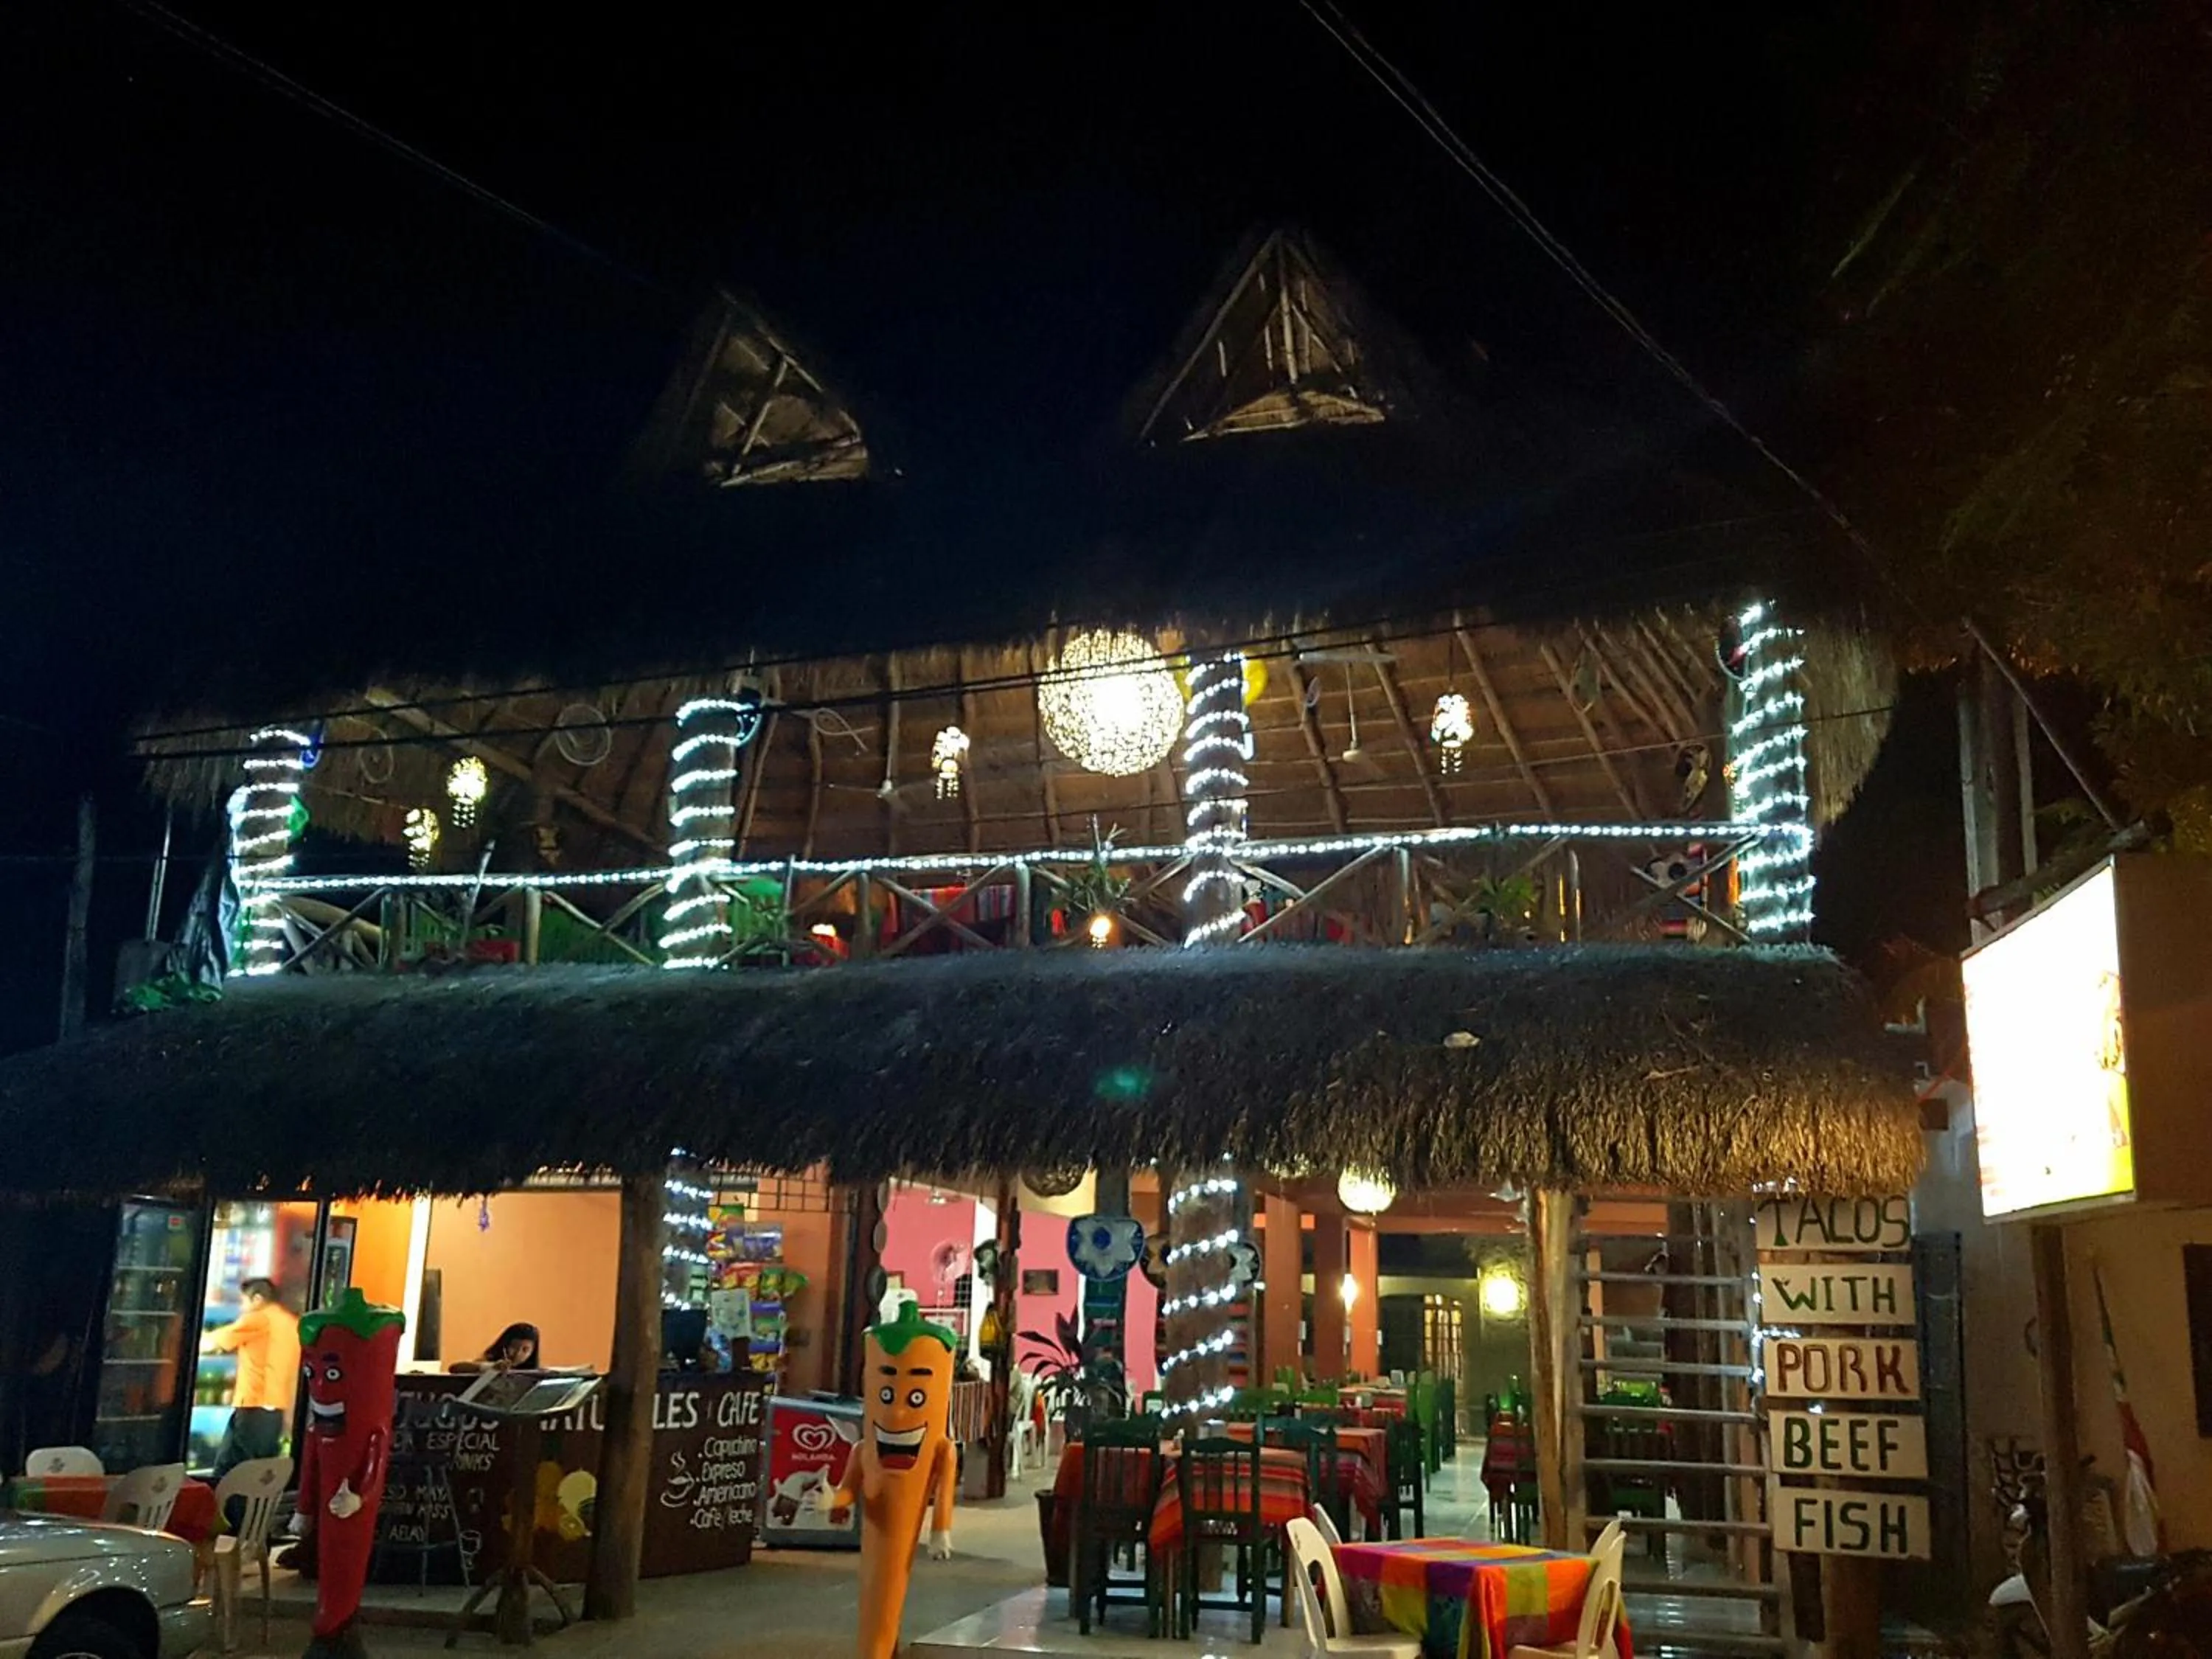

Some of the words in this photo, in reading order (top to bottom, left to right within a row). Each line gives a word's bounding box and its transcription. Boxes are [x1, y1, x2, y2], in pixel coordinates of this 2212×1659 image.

[1757, 1194, 1910, 1248] TACOS
[1771, 1276, 1896, 1314] WITH
[1776, 1342, 1910, 1394] PORK
[717, 1391, 761, 1427] CAFE
[1784, 1416, 1899, 1472] BEEF
[1794, 1498, 1907, 1554] FISH
